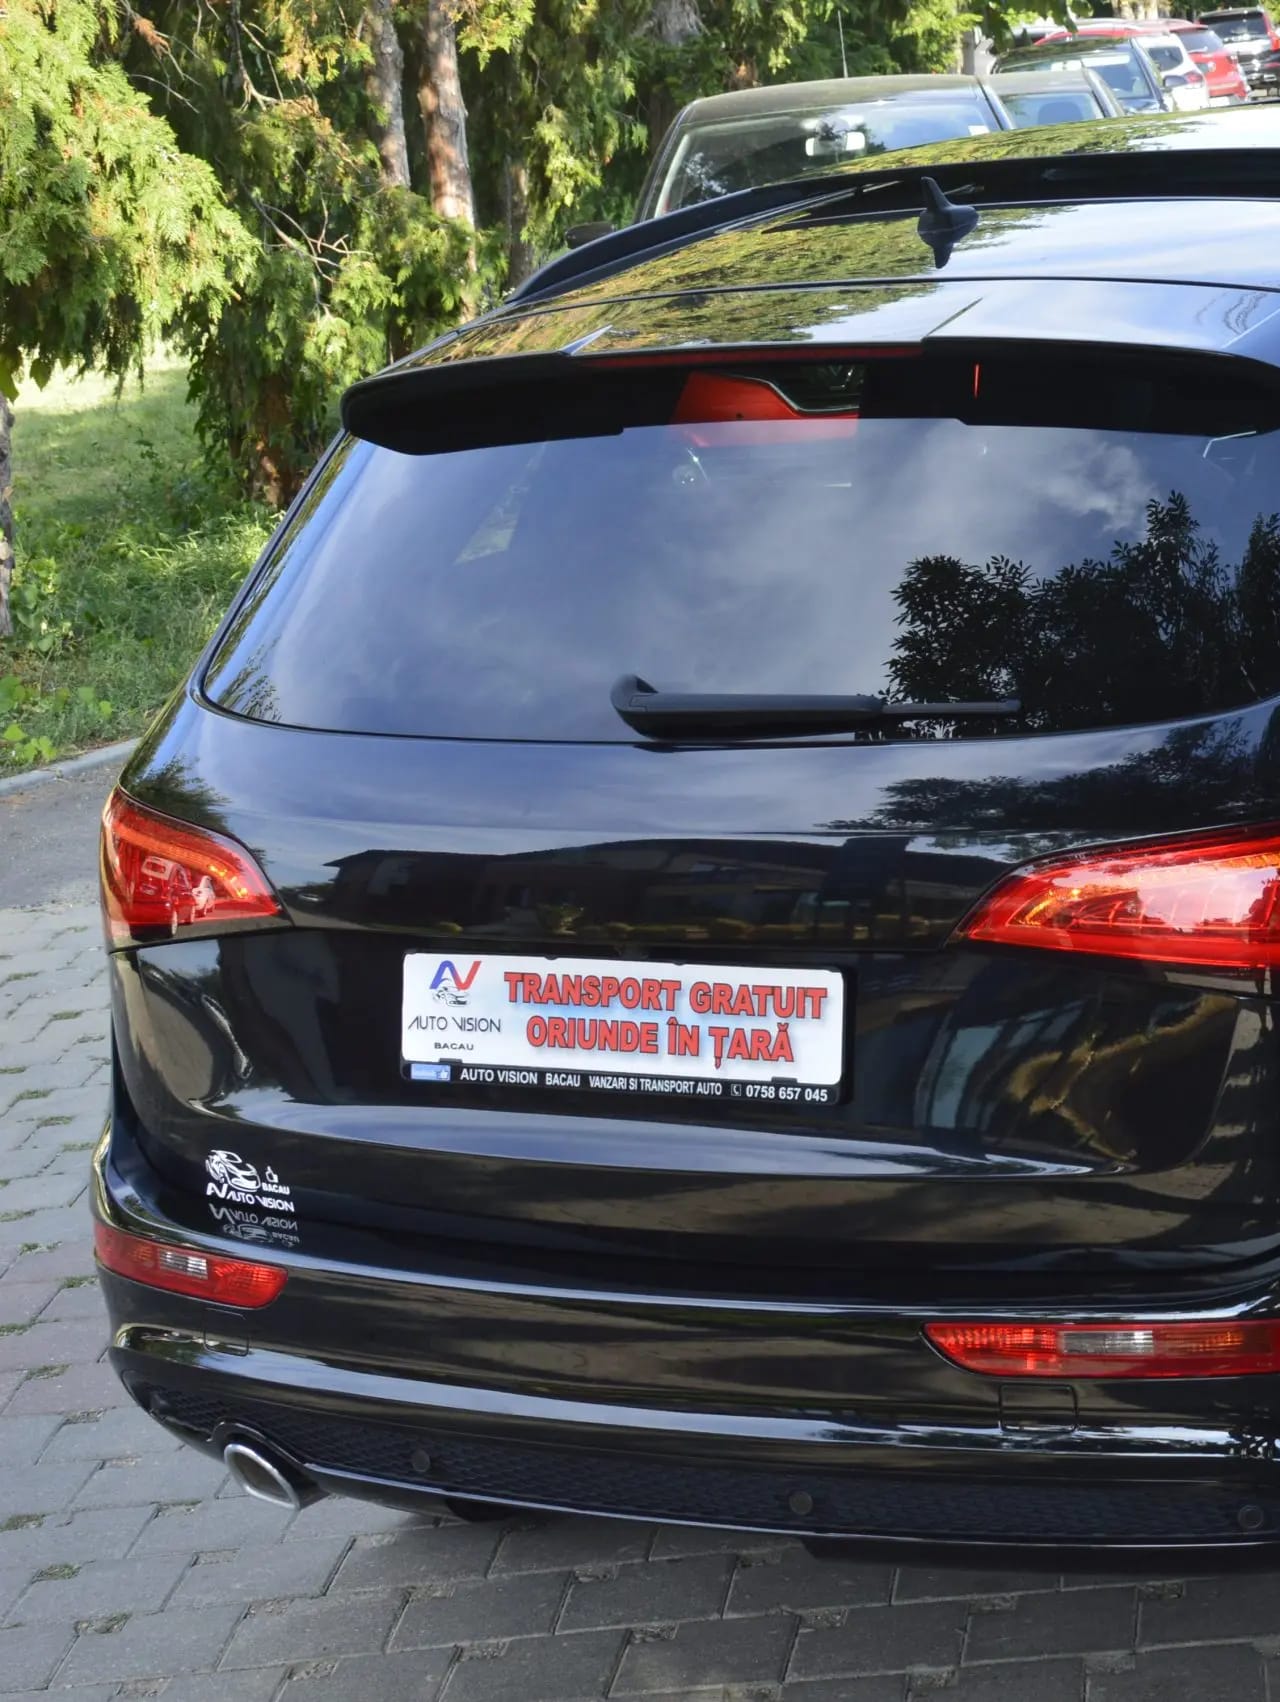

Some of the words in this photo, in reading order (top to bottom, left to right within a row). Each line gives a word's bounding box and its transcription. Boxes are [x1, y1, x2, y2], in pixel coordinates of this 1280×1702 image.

[504, 971, 682, 1011] TRANSPORT
[689, 981, 828, 1019] GRATUIT
[408, 1015, 448, 1031] AUTO
[451, 1016, 502, 1033] VISION
[526, 1015, 659, 1054] ORIUNDE
[666, 1016, 700, 1056] ÎN
[433, 1041, 475, 1051] BACAU
[460, 1067, 495, 1082] AUTO
[497, 1069, 538, 1085] VISION
[545, 1072, 581, 1088] BACAU
[589, 1075, 627, 1090] VANZARI
[629, 1077, 638, 1091] SI
[640, 1078, 695, 1095] TRANSPORT
[696, 1081, 723, 1096] AUTO
[746, 1084, 776, 1100] 0758
[778, 1086, 800, 1100] 657
[804, 1088, 828, 1102] 045
[261, 1182, 291, 1195] BACAU
[226, 1192, 256, 1205] AUTO
[255, 1195, 295, 1212] VISION
